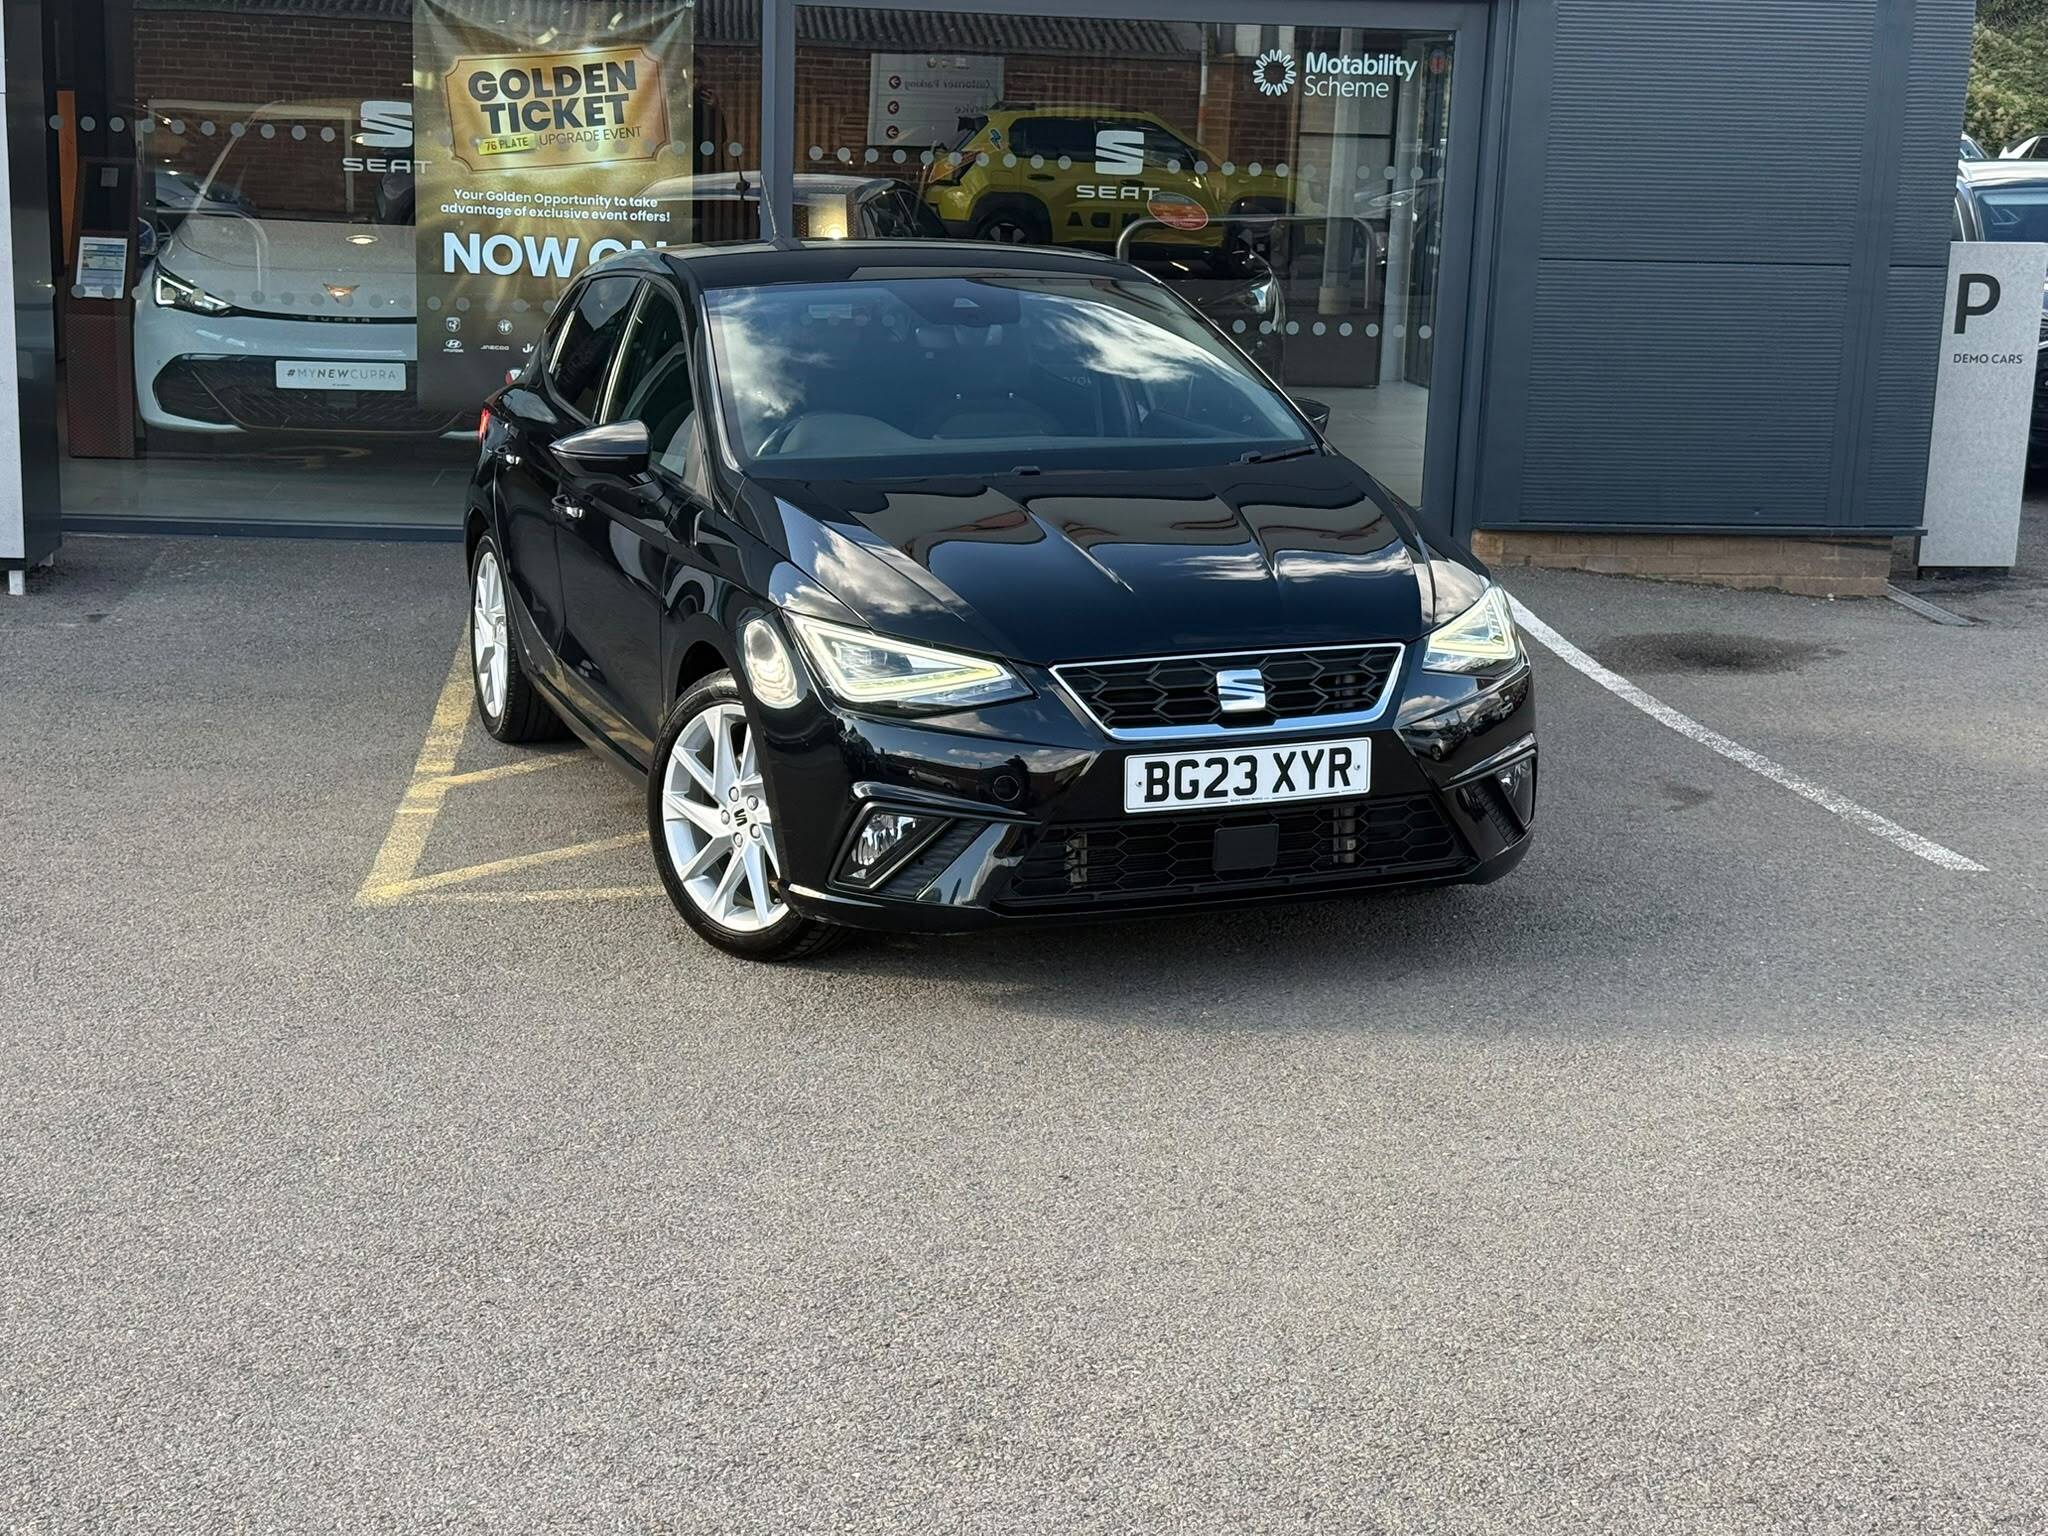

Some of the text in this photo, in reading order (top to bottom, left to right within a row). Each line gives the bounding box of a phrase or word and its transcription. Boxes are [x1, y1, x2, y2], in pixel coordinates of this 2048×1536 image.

[1305, 51, 1418, 82] Motability
[468, 60, 637, 102] GOLDEN
[1304, 75, 1389, 98] Scheme
[480, 93, 629, 134] TICKET
[485, 125, 643, 151] 76 PLATE UPGRADE EVENT
[342, 157, 432, 174] SEAT
[453, 188, 658, 209] Your Golden Opportunity to take
[1076, 185, 1161, 200] SEAT
[440, 203, 671, 222] advantage of exclusive event offers!
[443, 232, 580, 279] NOW
[1953, 273, 2001, 334] P
[1953, 353, 2024, 364] DEMO CARS
[1144, 746, 1353, 803] BG23 XYR
